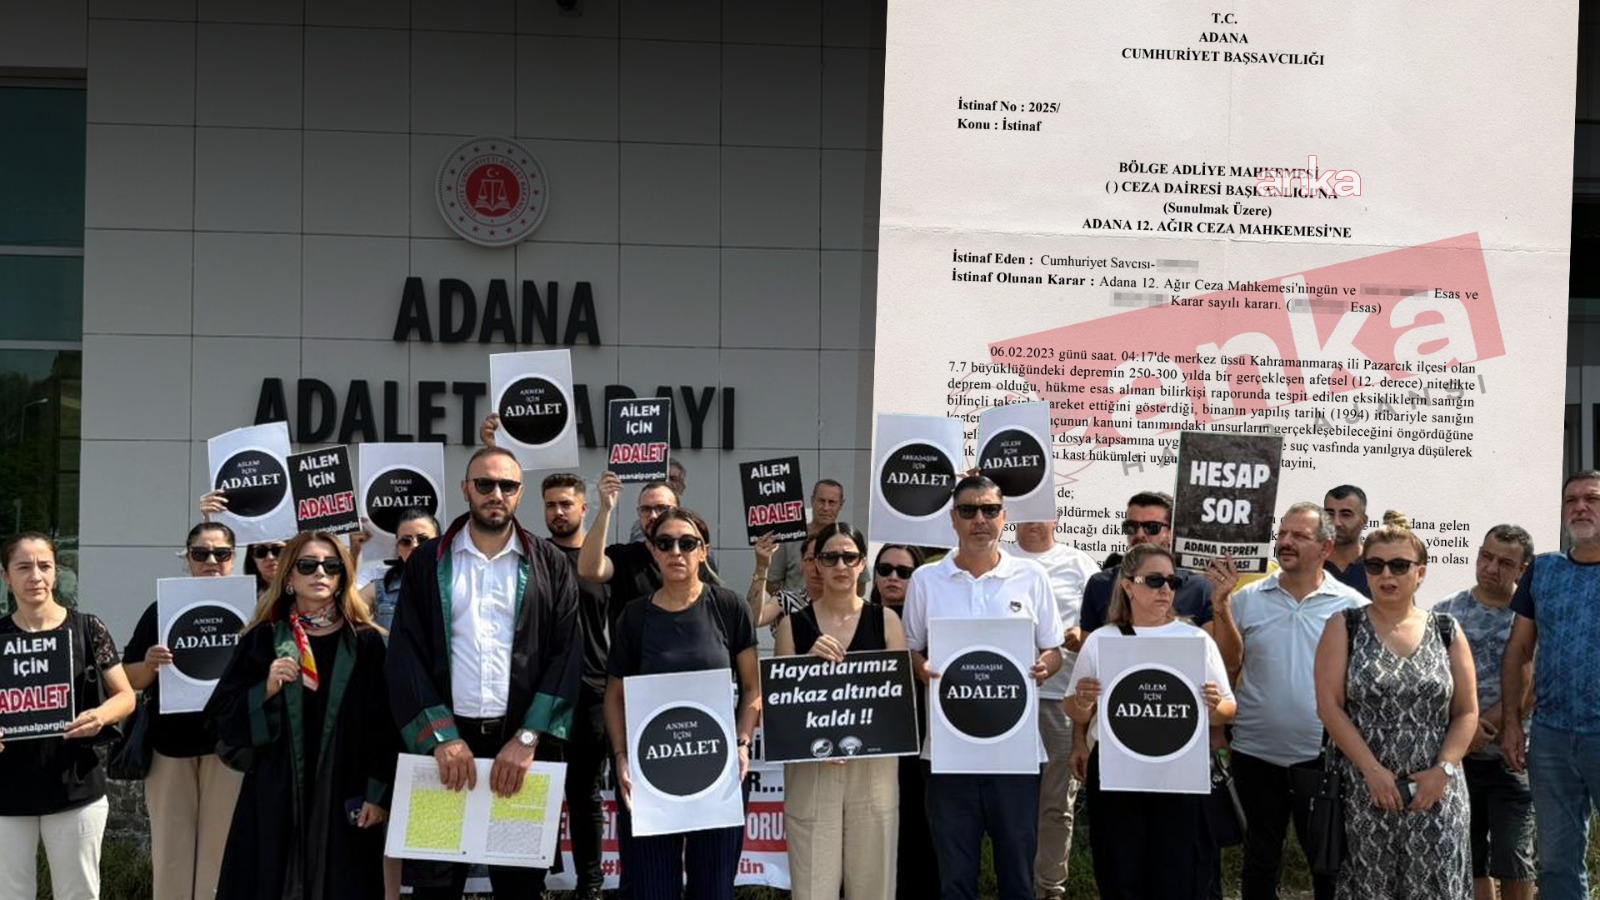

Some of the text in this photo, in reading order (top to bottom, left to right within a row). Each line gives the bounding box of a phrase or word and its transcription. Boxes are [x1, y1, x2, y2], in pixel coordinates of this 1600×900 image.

[1211, 12, 1238, 24] T.C.
[1198, 32, 1249, 44] ADANA
[1121, 47, 1325, 66] CUMHURİYET BAŞSAVCILIĞI
[957, 96, 1061, 114] İstinaf No 2025/
[957, 116, 1043, 132] Konu İstinaf
[1118, 159, 1168, 175] BÖLGE
[1172, 162, 1226, 177] ADLİYE
[1121, 181, 1160, 194] CEZA
[1164, 180, 1222, 195] DAİRESİ
[1163, 200, 1272, 219] (Sunulmak Üzere)
[1082, 218, 1352, 238] ADANA 12. AĞIR CEZA MAHKEMESİ'NE
[952, 248, 992, 264] İstinaf
[994, 253, 1025, 265] Eden
[1040, 254, 1107, 270] Cumhuriyet
[952, 267, 993, 283] İstinaf
[996, 272, 1043, 285] Olunan
[1047, 273, 1086, 286] Karar
[1099, 276, 1137, 288] Adana
[1143, 277, 1159, 289] 12.
[1163, 278, 1191, 293] Ağır
[1194, 279, 1224, 291] Ceza
[1227, 280, 1338, 298] Mahkemesi'ningün
[1342, 287, 1357, 296] ve
[1434, 287, 1461, 299] Esas
[1465, 291, 1479, 300] ve
[393, 277, 601, 345] ADANA
[1170, 295, 1204, 308] Karar
[1208, 296, 1239, 311] sayılı
[1244, 297, 1281, 310] kararı.
[1350, 301, 1382, 315] Esas)
[990, 346, 1476, 375] 06.02.2023 günü saat. 04:17'de merkez üssü Kahramanmaraş ili Pazarcık ilçesi olan
[948, 361, 1476, 391] 7.7 büyüklüğündeki depremin 250-300 yılda bir gerçekleşen afetsel (12. derece) nitelikte
[947, 377, 1475, 410] deprem olduğu, hükme esas alınan bilirkişi raporunda tespit edilen eksikliklerin sanığın
[254, 377, 486, 447] ADALET
[504, 402, 562, 417] ADALET
[620, 403, 661, 418] AİLEM
[947, 394, 1475, 427] bilinçli ettiğini gösterdiği, binanın yapılış tarihi (1994) itibariyle sanığın
[626, 419, 653, 436] İÇİN
[1093, 416, 1474, 443] kanuni tanımındaki unsurların gerçekleşebileceğini öngördüğüne
[609, 442, 668, 464] ADALET
[1058, 432, 1473, 458] dosya kapsamına suç vasfında yanılgıya düşülerek
[299, 453, 340, 473] AİLEM
[983, 454, 1040, 470] ADALET
[1062, 448, 1316, 470] kast hükümleri tayini,
[307, 470, 336, 489] İÇİN
[750, 463, 791, 479] AİLEM
[886, 472, 951, 487] ADALET
[1189, 460, 1271, 489] HESAP
[220, 472, 281, 490] ADALET
[758, 480, 786, 496] İÇİN
[298, 491, 355, 521] ADALET
[371, 494, 432, 508] ADALET
[1201, 497, 1252, 524] SOR
[748, 500, 803, 526] ADALET
[1056, 506, 1470, 533] öldürmek gelen
[1055, 523, 1470, 549] olacağı yönelik
[1073, 540, 1469, 565] kastla olası
[1184, 541, 1259, 556] ADANA DEPREM
[3, 636, 57, 656] AİLEM
[174, 633, 242, 650] ADALET
[13, 658, 49, 677] İÇİN
[769, 658, 898, 682] Hayatlarımız
[960, 663, 1004, 673] ARKADAŞIM
[974, 672, 990, 682] İÇİN
[768, 680, 903, 705] enkaz altında
[946, 684, 1020, 700] ADALET
[1138, 682, 1167, 691] AİLEM
[1143, 691, 1162, 701] İÇİN
[0, 683, 70, 714] ADALET
[806, 708, 874, 728] kaldı !!
[1115, 703, 1190, 719] ADALET
[665, 720, 698, 731] ANNEM
[673, 730, 692, 741] İÇİN
[645, 738, 720, 760] ADALET
